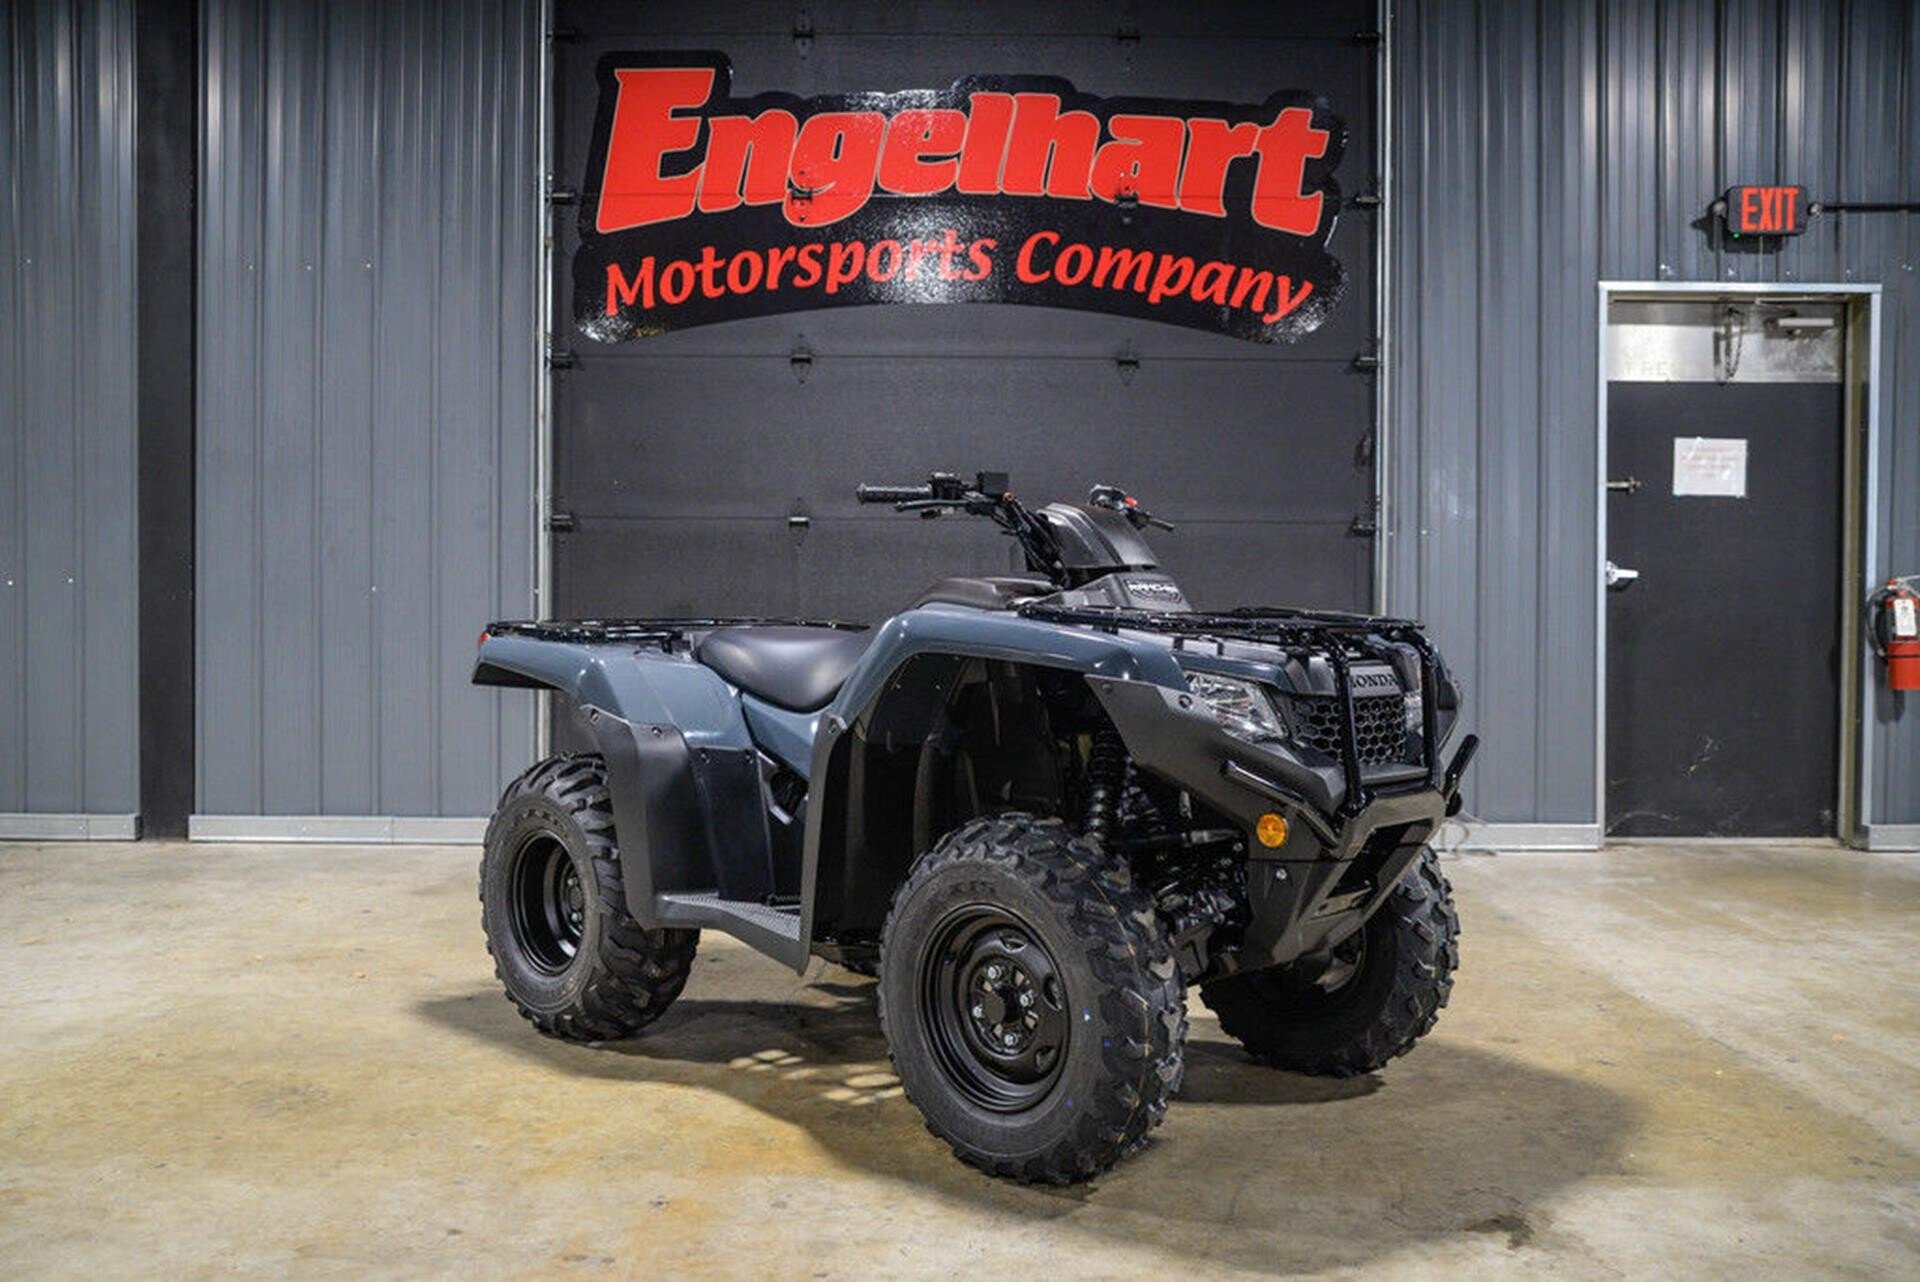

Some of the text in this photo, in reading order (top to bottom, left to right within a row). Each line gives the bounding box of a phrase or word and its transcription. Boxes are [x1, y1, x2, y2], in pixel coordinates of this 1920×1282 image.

[596, 68, 1330, 236] Engelhart
[1740, 187, 1800, 231] EXIT
[605, 228, 1314, 324] Motorsports Company
